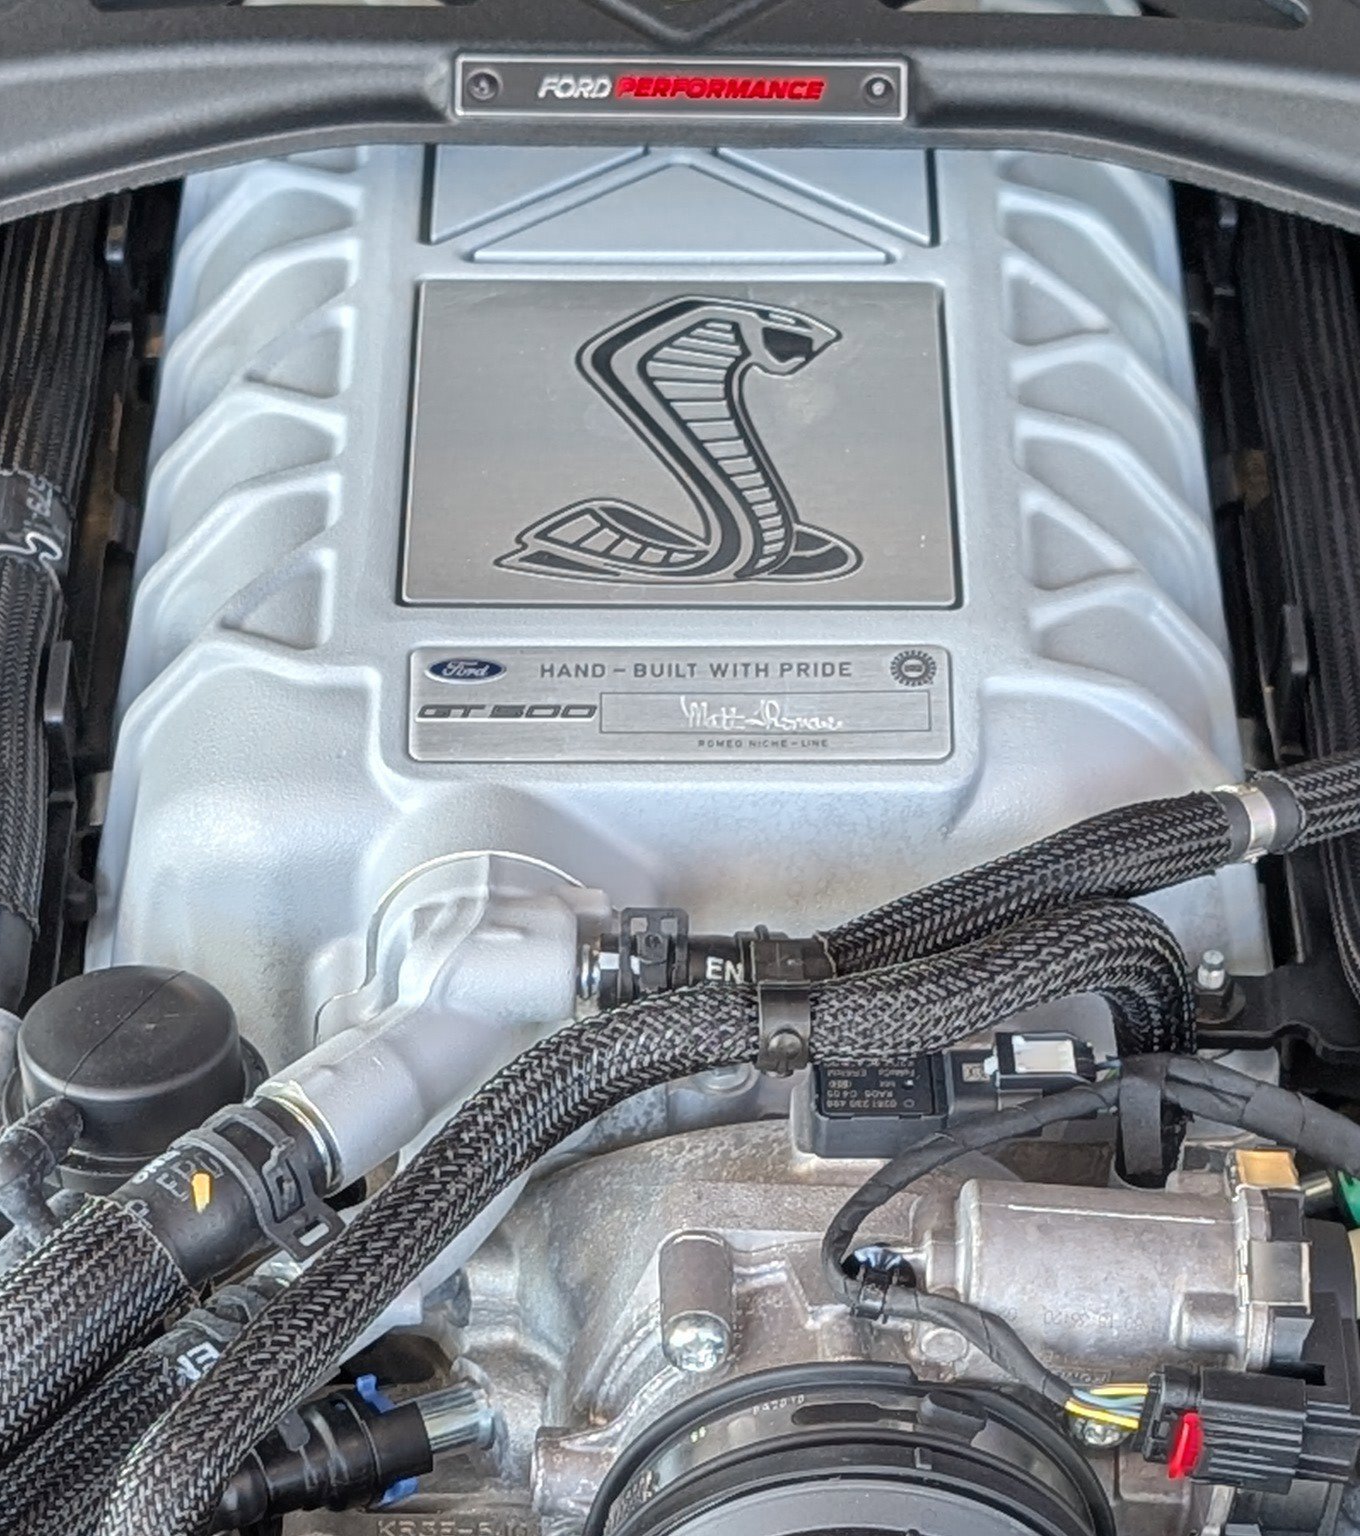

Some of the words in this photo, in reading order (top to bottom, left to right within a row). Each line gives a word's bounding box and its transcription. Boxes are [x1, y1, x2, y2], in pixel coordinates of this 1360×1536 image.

[538, 76, 611, 99] FORD
[615, 77, 825, 100] PERFORMANCE
[539, 663, 608, 679] HAND
[634, 662, 697, 679] BUILT
[709, 662, 769, 679] WITH
[779, 661, 854, 679] PRIDE
[697, 739, 743, 748] ROMEO
[749, 739, 788, 748] NICHE
